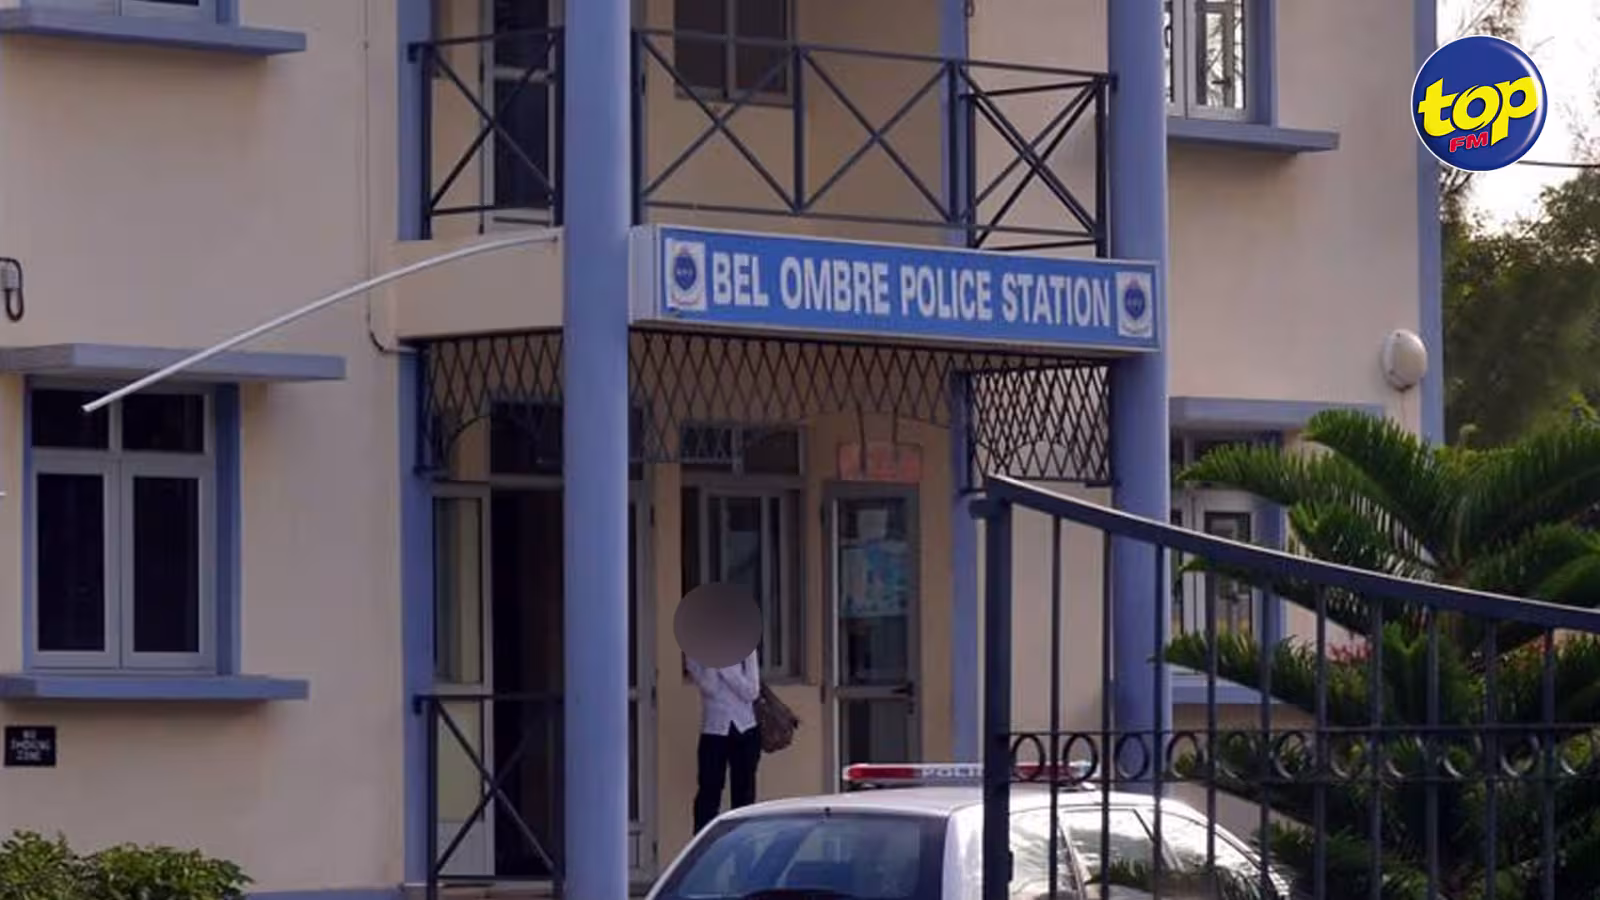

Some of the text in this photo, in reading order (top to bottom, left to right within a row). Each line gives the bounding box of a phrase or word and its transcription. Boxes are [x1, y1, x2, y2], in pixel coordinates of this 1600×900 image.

[712, 251, 1111, 328] BEL OMBRE POLICE STATION
